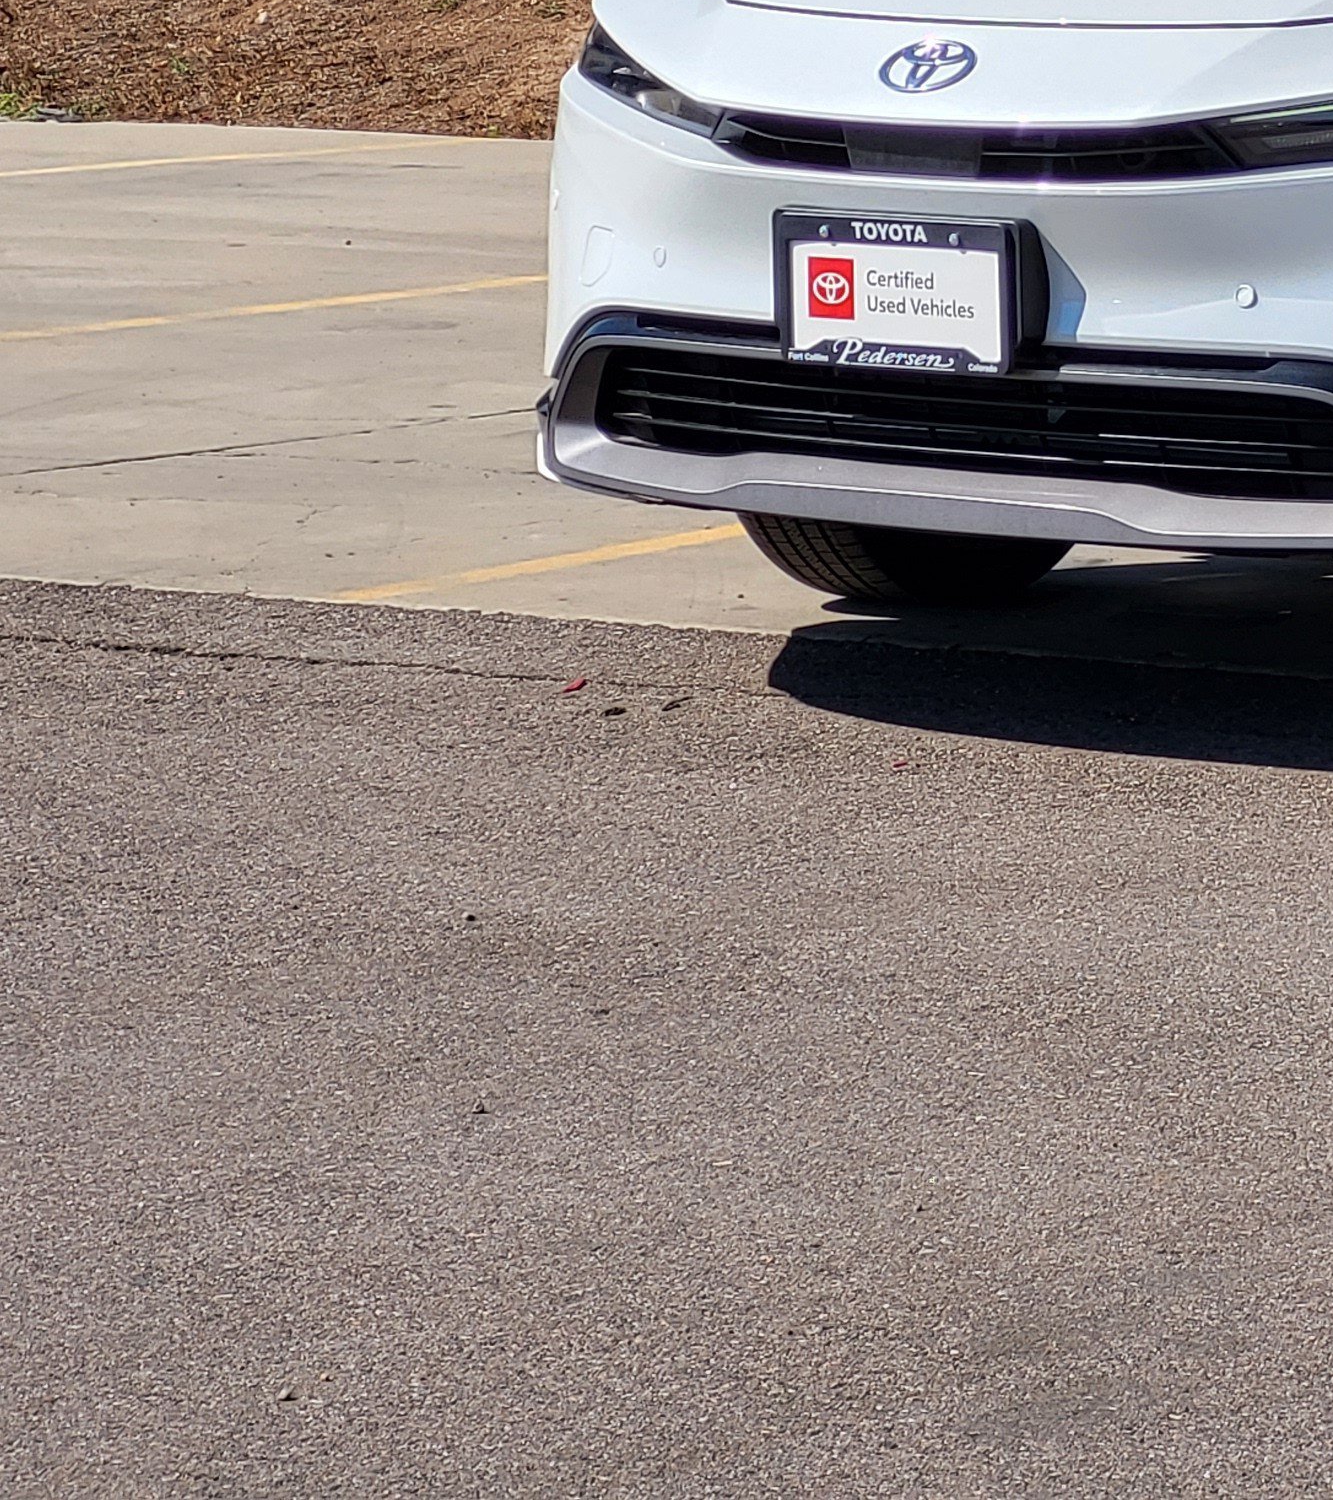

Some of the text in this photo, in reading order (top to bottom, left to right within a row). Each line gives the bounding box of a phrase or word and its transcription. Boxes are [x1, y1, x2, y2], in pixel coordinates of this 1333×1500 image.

[851, 220, 928, 243] TOYOTA
[866, 269, 934, 290] Certified
[866, 295, 975, 319] Used Vehicles
[833, 337, 955, 369] Pedersen
